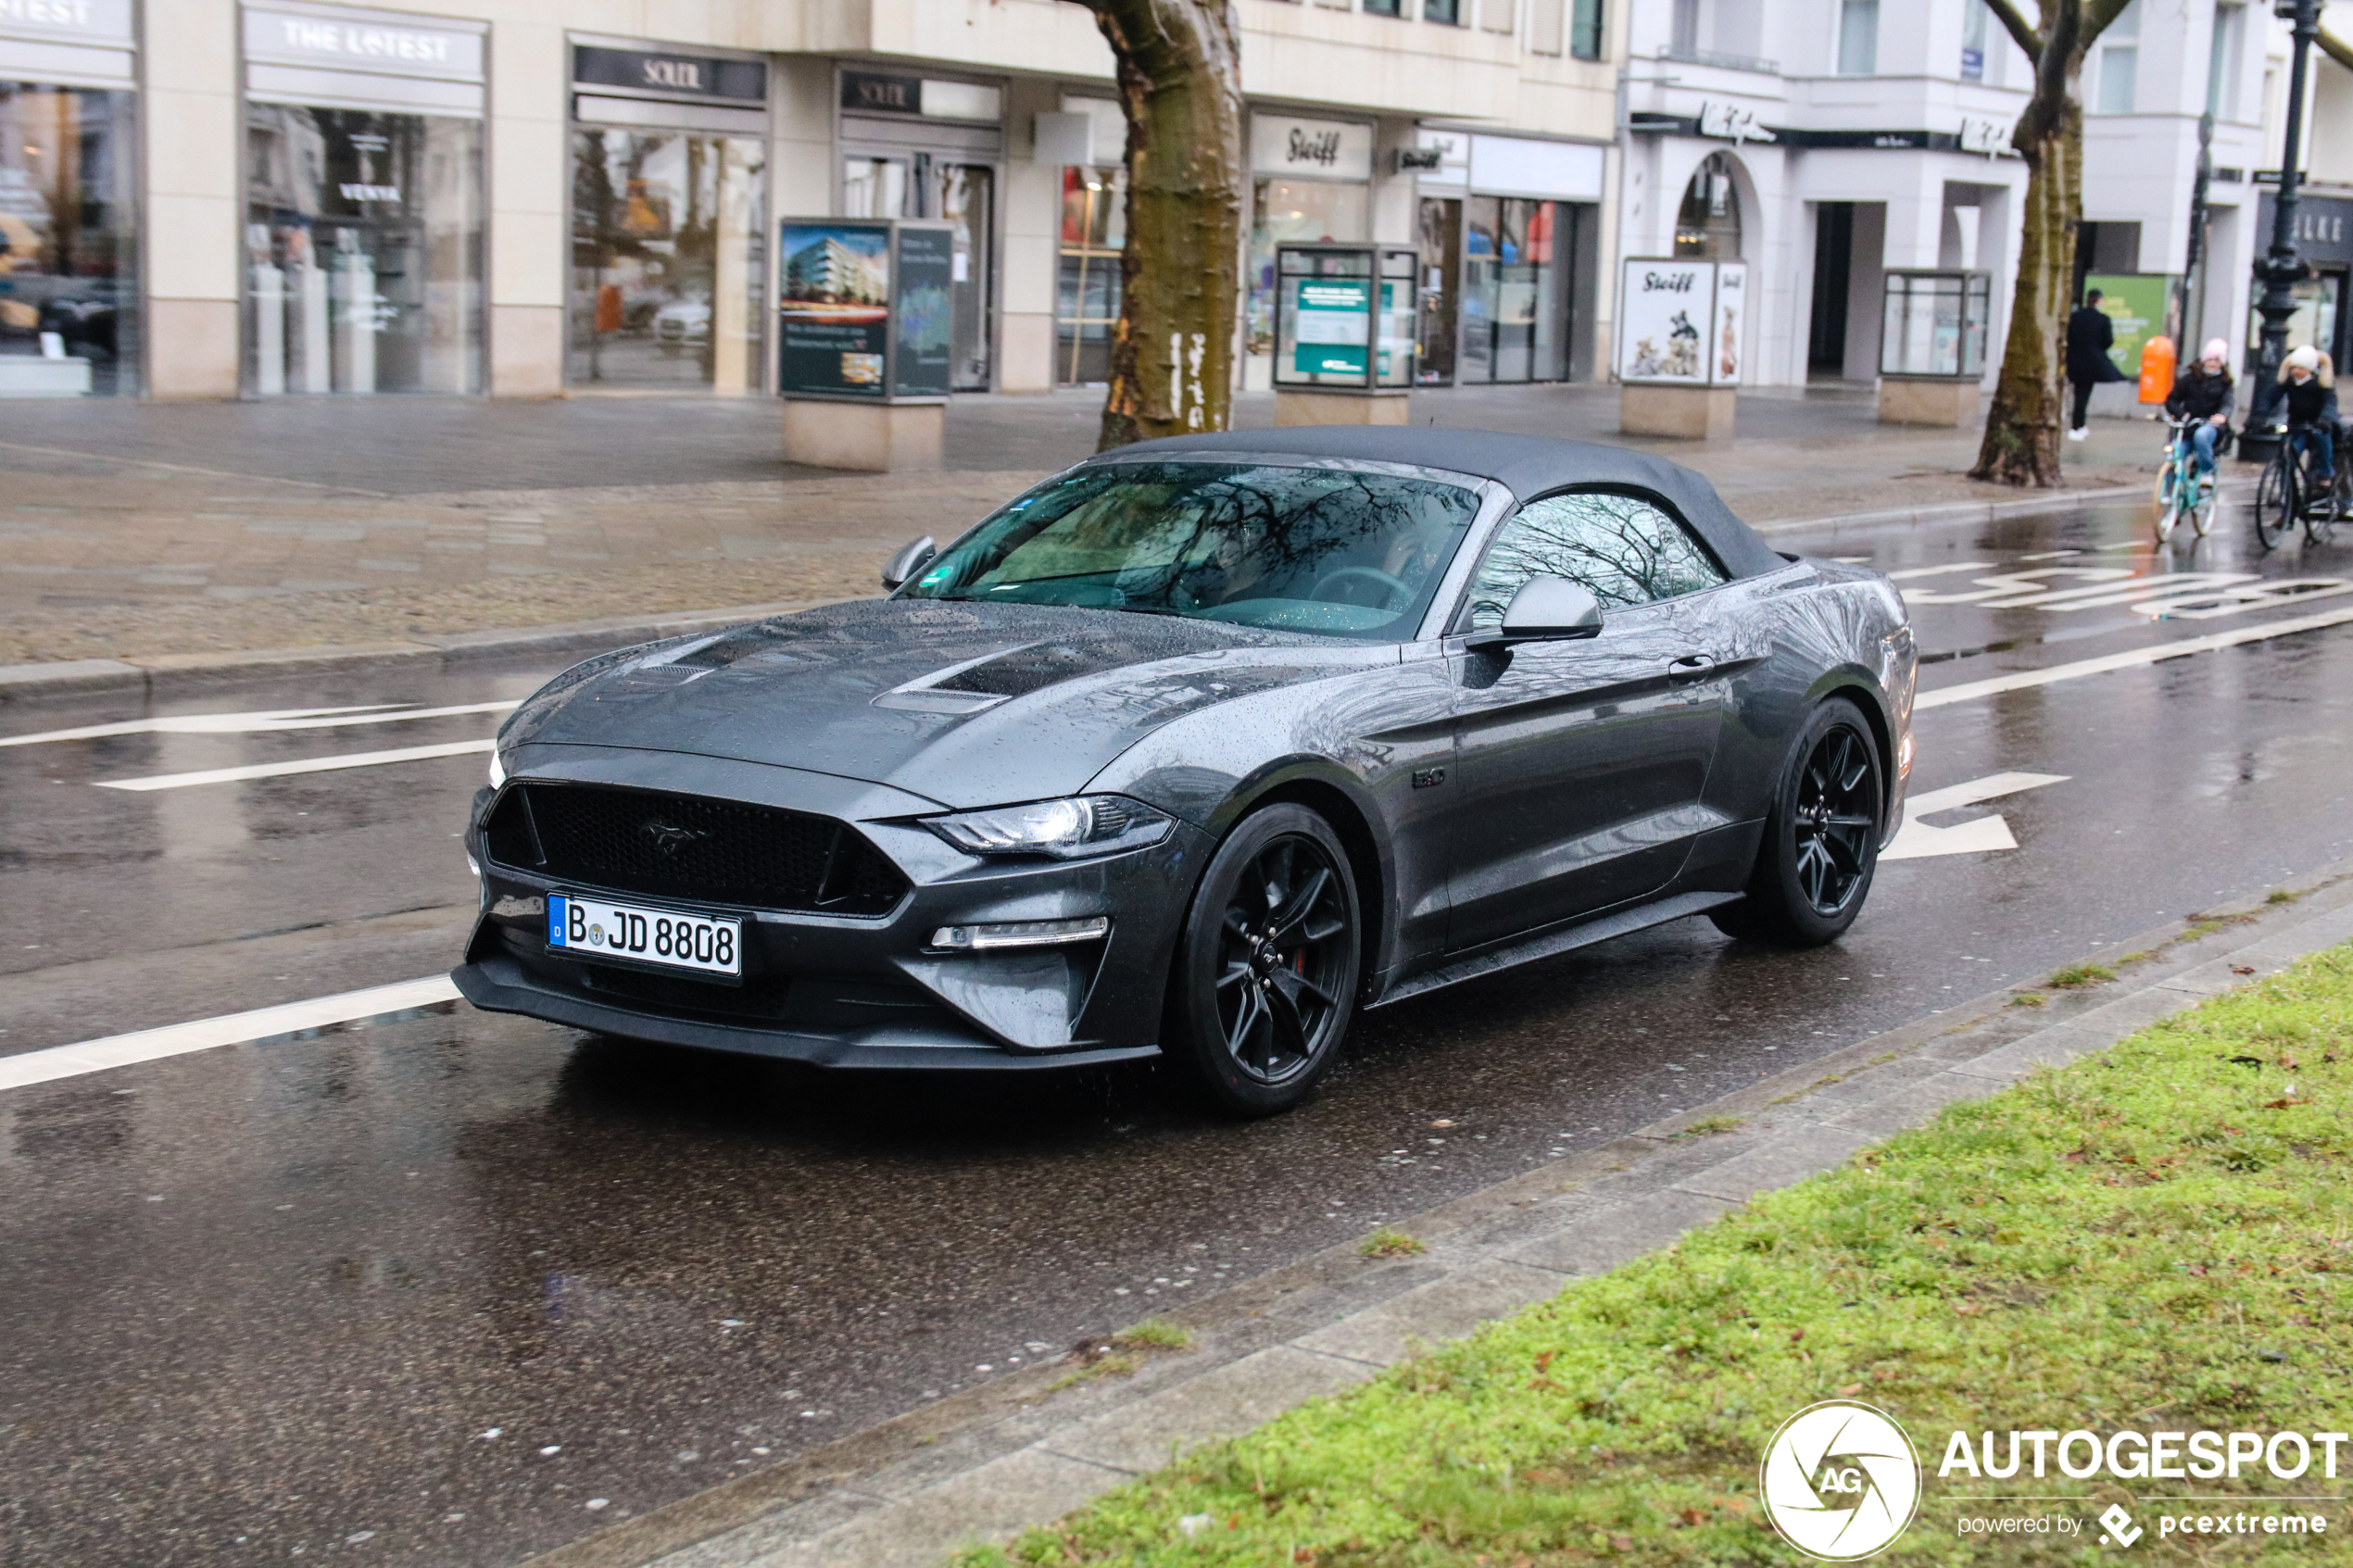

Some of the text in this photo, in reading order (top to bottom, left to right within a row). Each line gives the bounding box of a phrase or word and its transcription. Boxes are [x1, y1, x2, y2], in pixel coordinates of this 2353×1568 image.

[283, 19, 341, 52] THE
[1287, 127, 1340, 167] Steiff
[1642, 270, 1695, 294] Steiff
[554, 926, 560, 937] D
[569, 904, 734, 965] B JD 8808
